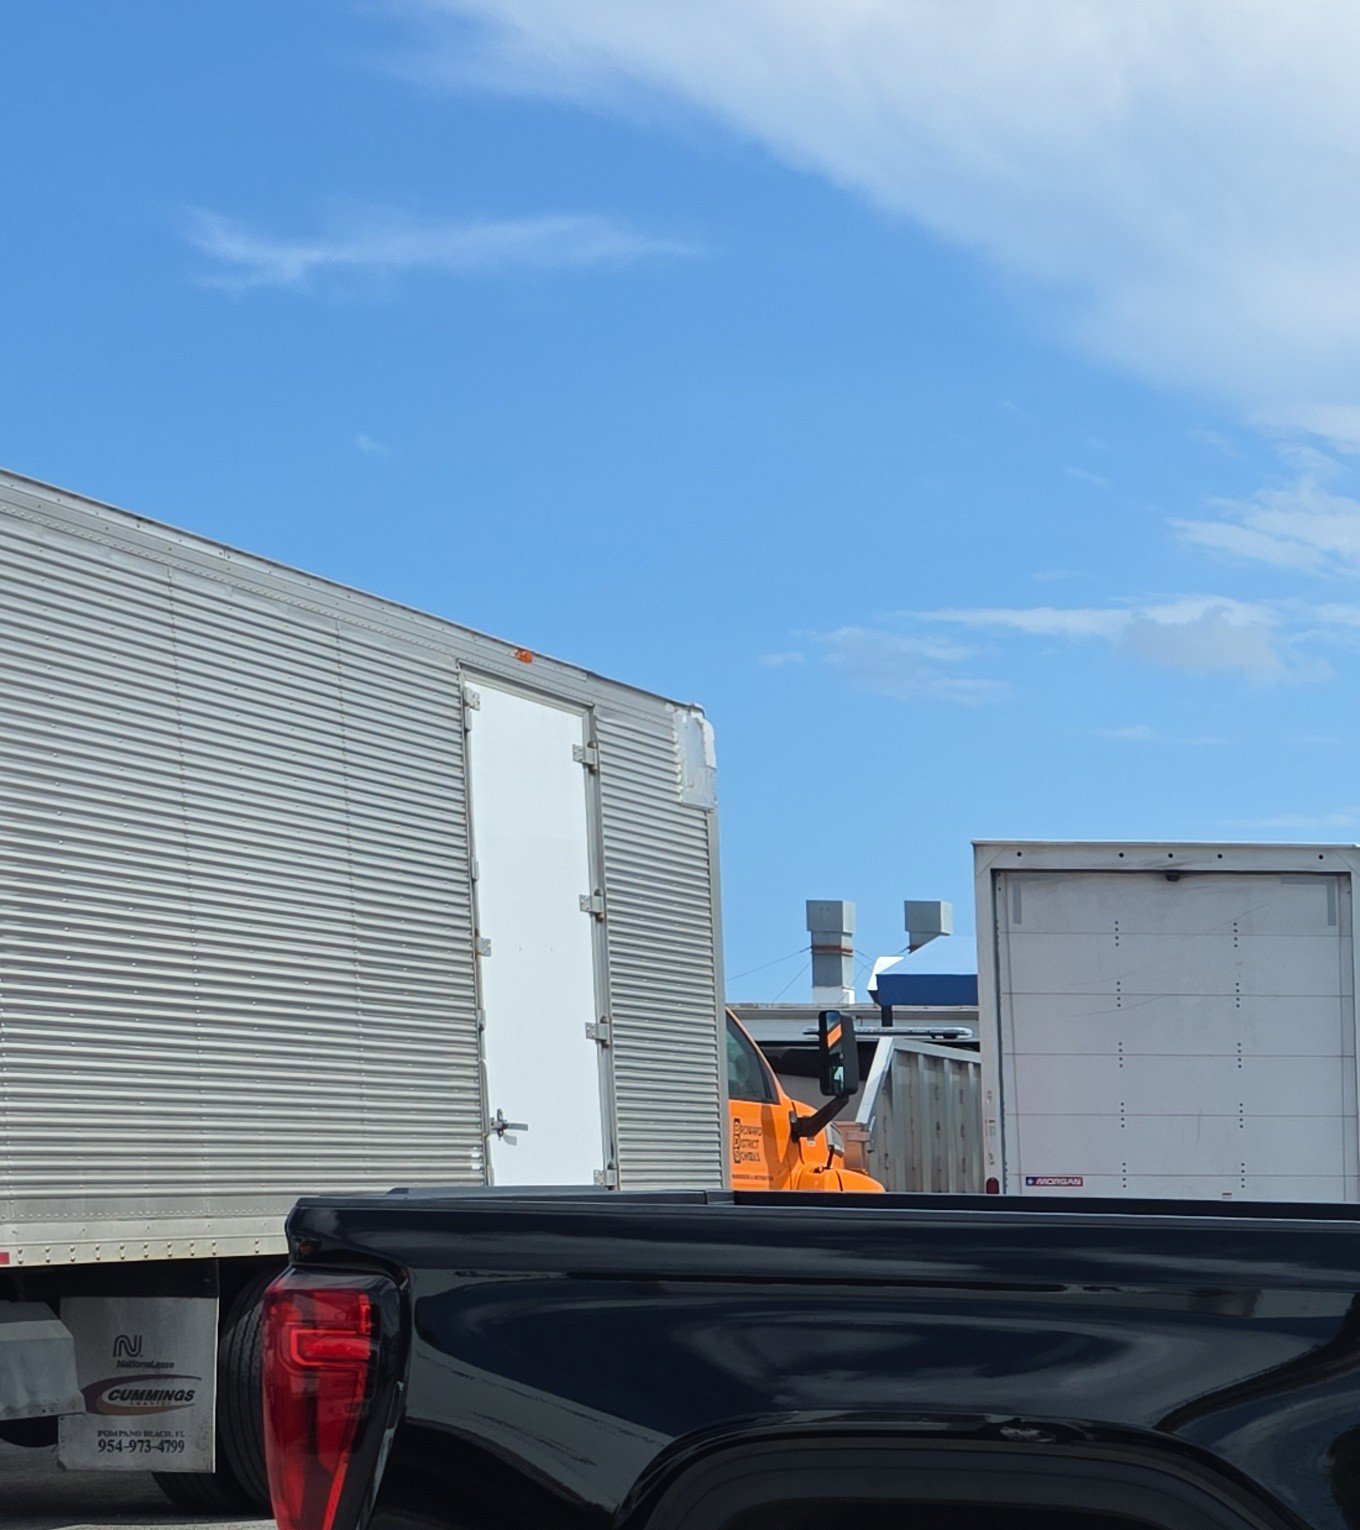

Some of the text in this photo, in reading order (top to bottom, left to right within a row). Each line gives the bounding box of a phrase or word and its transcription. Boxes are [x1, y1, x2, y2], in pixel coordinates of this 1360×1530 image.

[1036, 1177, 1082, 1186] MORGAN
[108, 1389, 196, 1402] CUMMINGS
[97, 1439, 185, 1453] 954-973-4799
